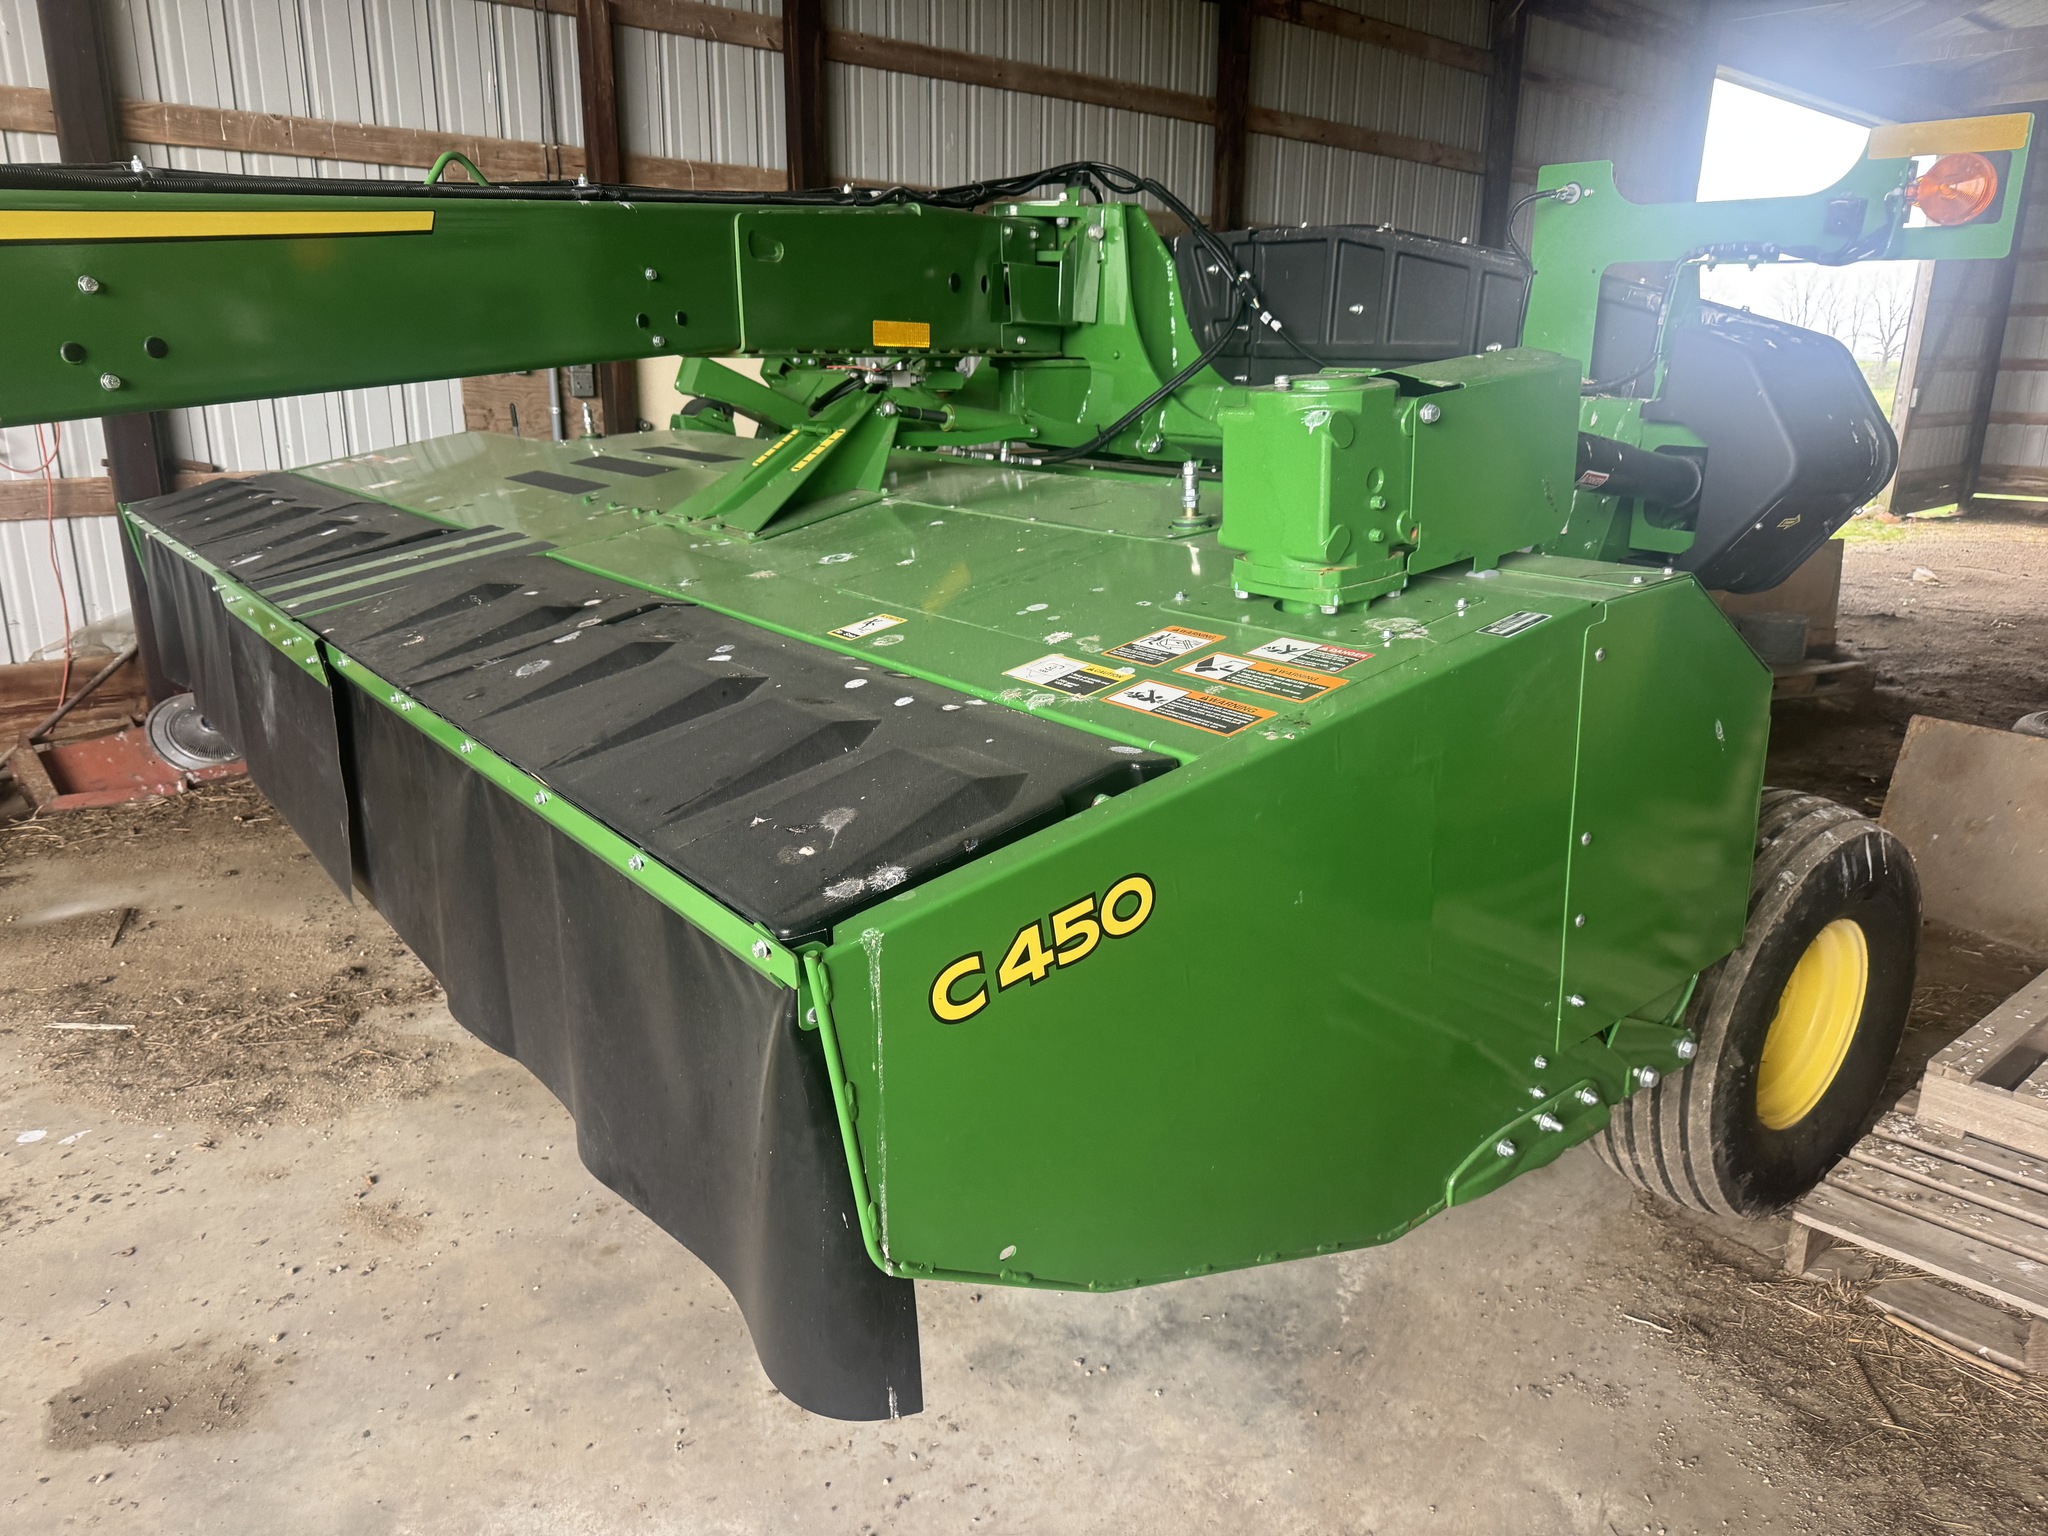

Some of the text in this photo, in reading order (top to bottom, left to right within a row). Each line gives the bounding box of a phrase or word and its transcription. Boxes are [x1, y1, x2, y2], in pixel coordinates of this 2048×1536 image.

[1331, 647, 1368, 659] DANGER
[1279, 668, 1319, 682] WARNING
[1208, 696, 1258, 713] WARNING
[928, 872, 1156, 1025] C 450
